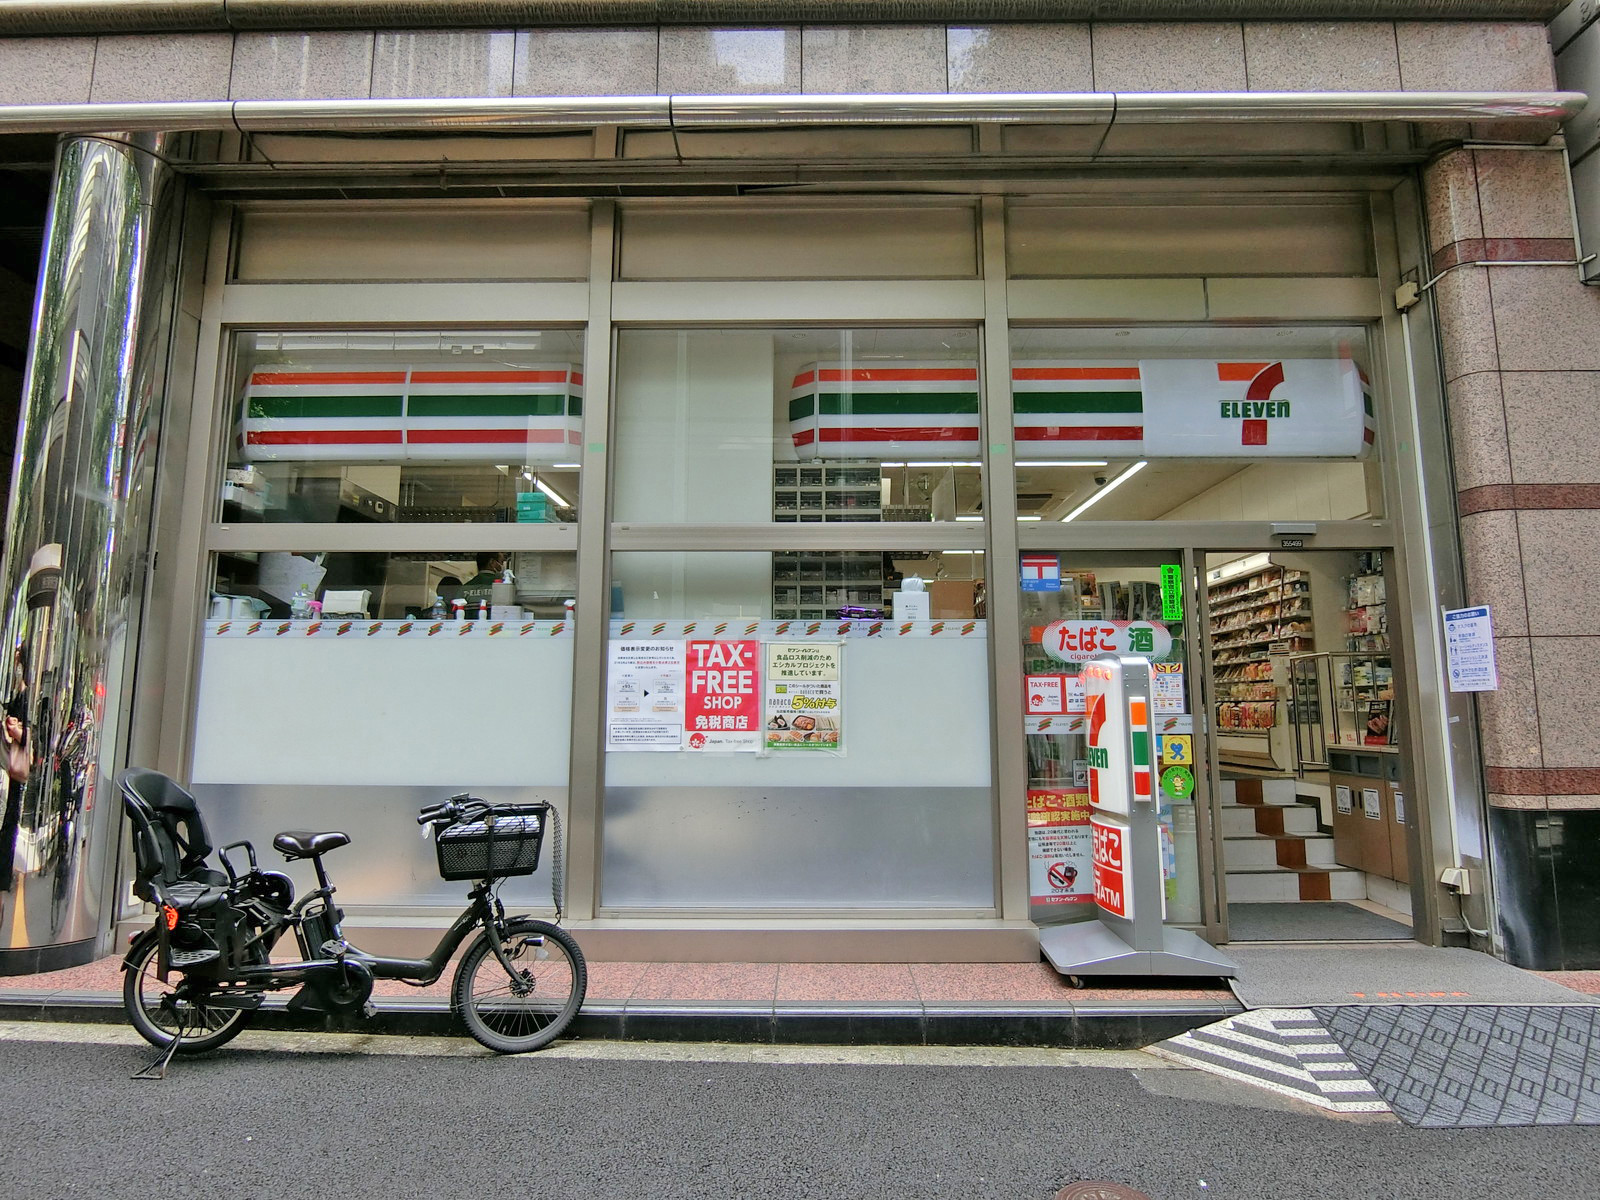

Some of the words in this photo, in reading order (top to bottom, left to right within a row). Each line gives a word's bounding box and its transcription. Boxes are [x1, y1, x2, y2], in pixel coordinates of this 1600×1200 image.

[1058, 626, 1117, 652] たばこ
[1128, 627, 1154, 653] 酒
[691, 643, 753, 667] TAX-
[691, 670, 753, 694] FREE
[704, 695, 742, 709] SHOP
[695, 715, 748, 730] 免税商店
[1028, 810, 1090, 822] 齢確認実施中
